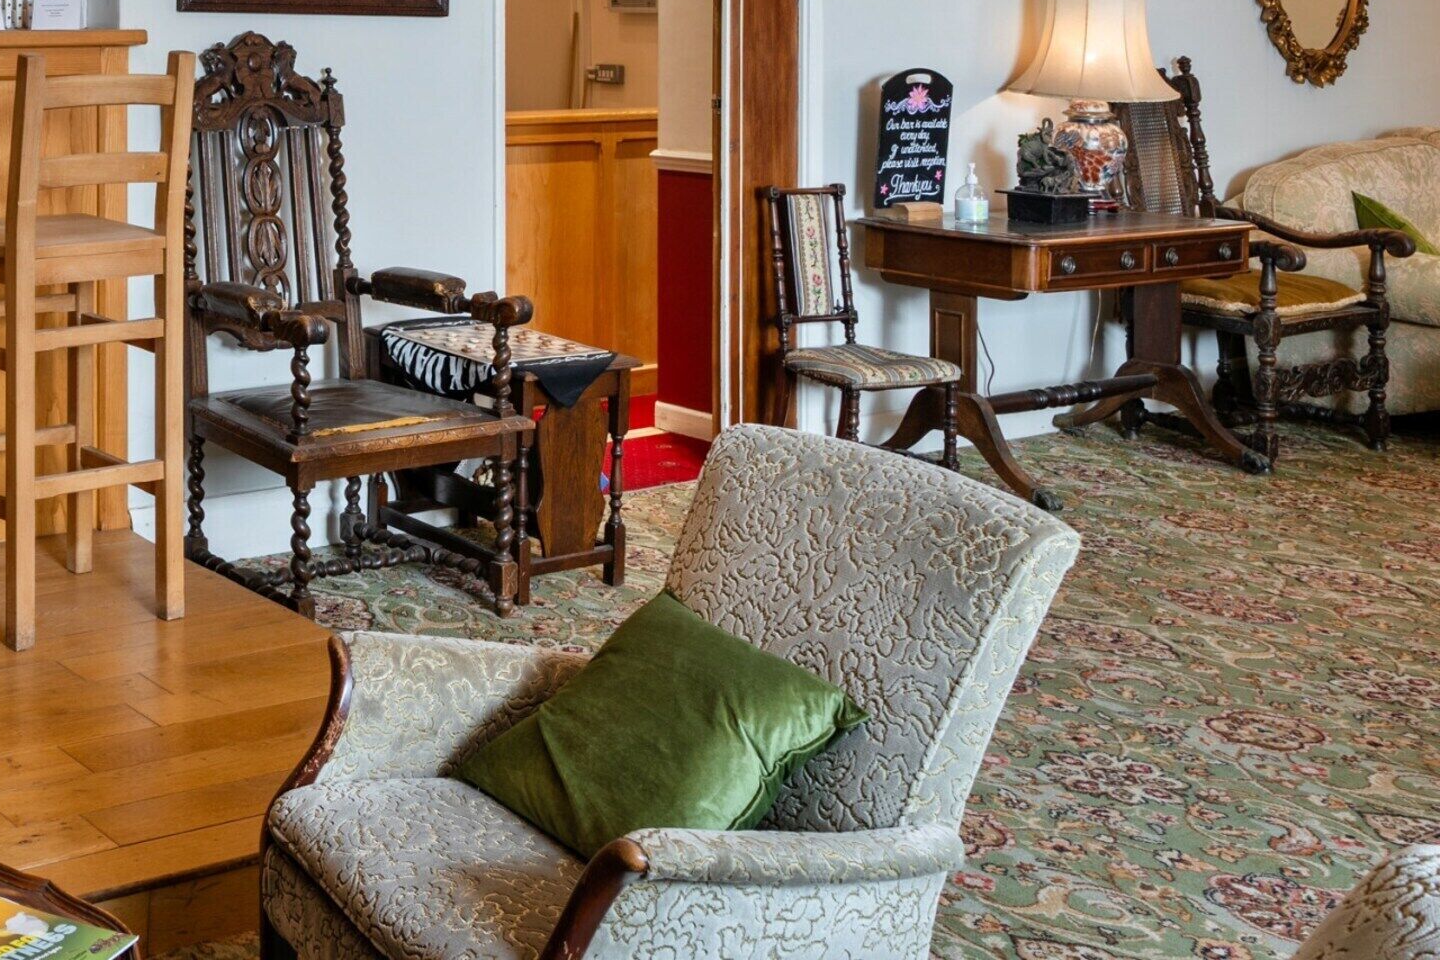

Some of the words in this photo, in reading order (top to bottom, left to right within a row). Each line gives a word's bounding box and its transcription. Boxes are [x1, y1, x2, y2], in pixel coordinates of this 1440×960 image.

[886, 118, 900, 130] Our
[900, 118, 915, 130] bar
[914, 119, 921, 129] is
[921, 118, 948, 129] available
[900, 131, 918, 142] every
[878, 159, 904, 174] please
[904, 157, 919, 168] visit
[448, 355, 497, 391] ACK
